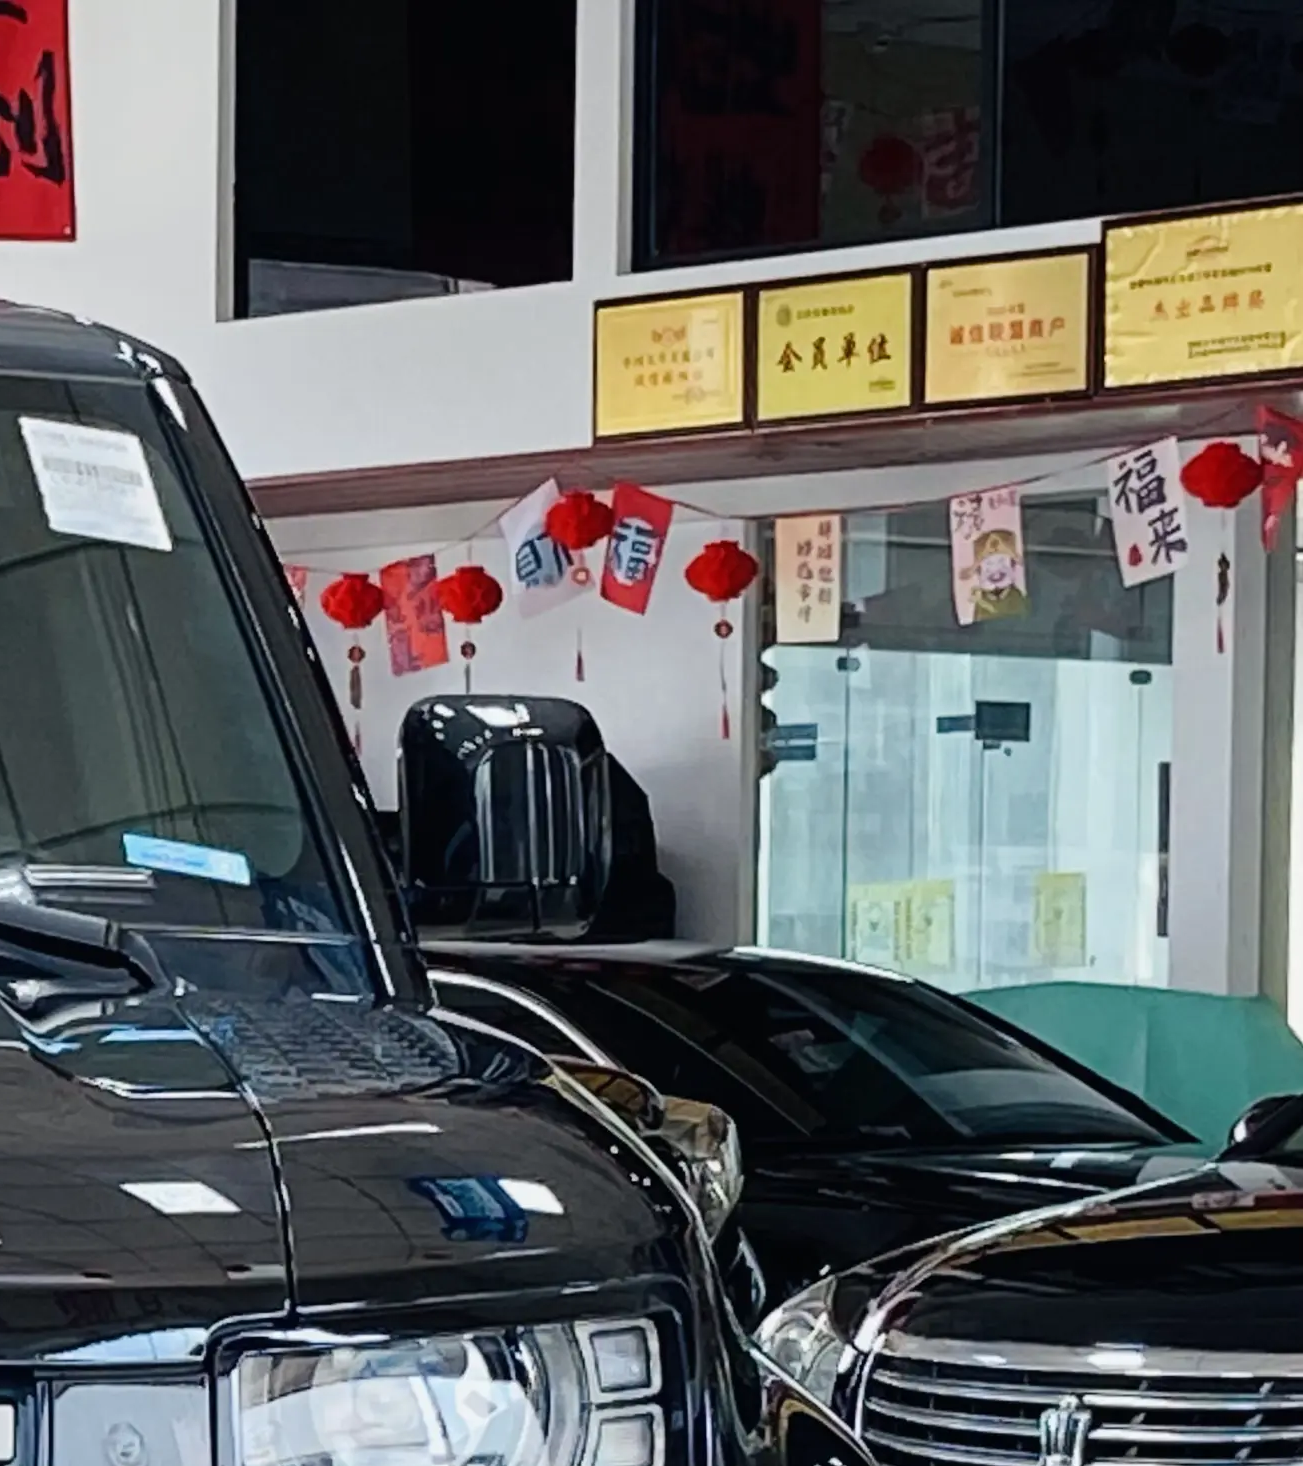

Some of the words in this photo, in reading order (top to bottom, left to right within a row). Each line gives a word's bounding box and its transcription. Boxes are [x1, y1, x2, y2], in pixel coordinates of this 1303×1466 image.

[776, 331, 892, 373] 会员单位
[1113, 449, 1188, 566] 福来
